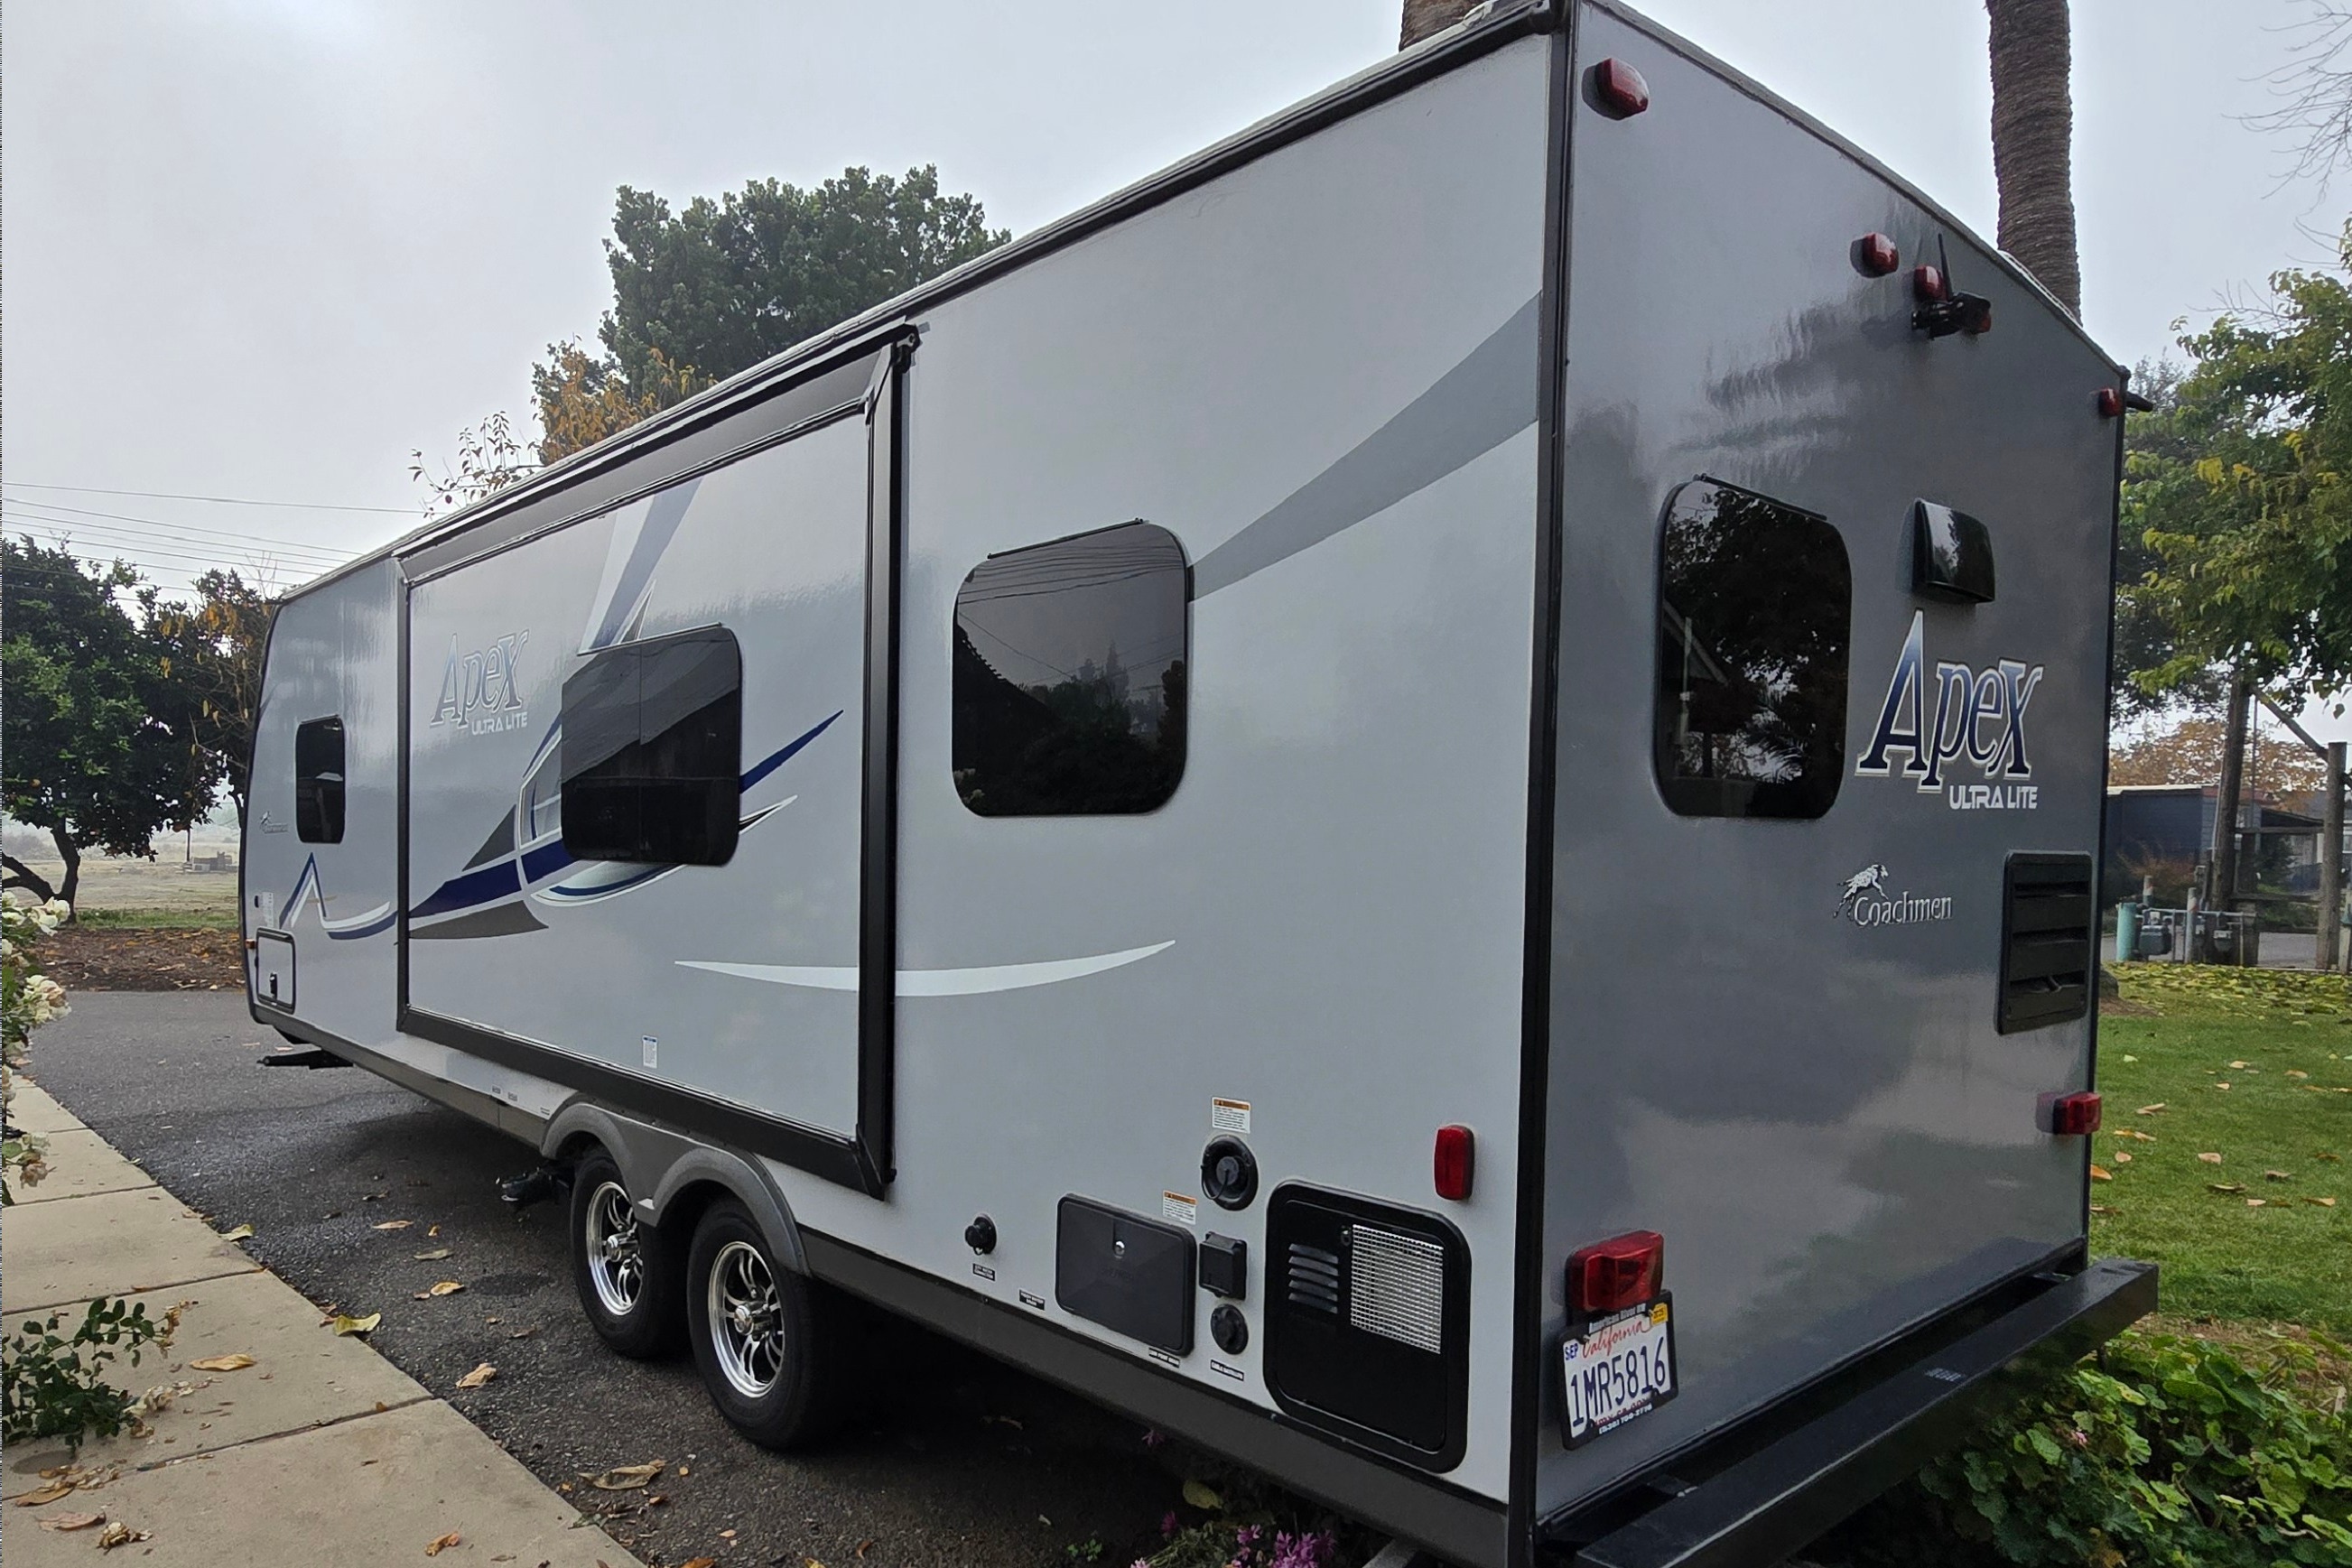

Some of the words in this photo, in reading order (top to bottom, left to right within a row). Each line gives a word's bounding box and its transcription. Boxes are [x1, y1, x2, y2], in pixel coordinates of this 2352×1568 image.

[430, 629, 529, 728] Apex
[1855, 608, 2044, 793] Apex
[471, 718, 504, 736] ULTRA
[506, 711, 528, 730] LITE
[1949, 784, 2003, 810] ULTRA
[2007, 785, 2039, 810] LITE
[1854, 891, 1953, 927] Coachmen
[1565, 1343, 1579, 1360] SEP
[1582, 1320, 1650, 1359] California
[1570, 1336, 1667, 1427] 1MR5816
